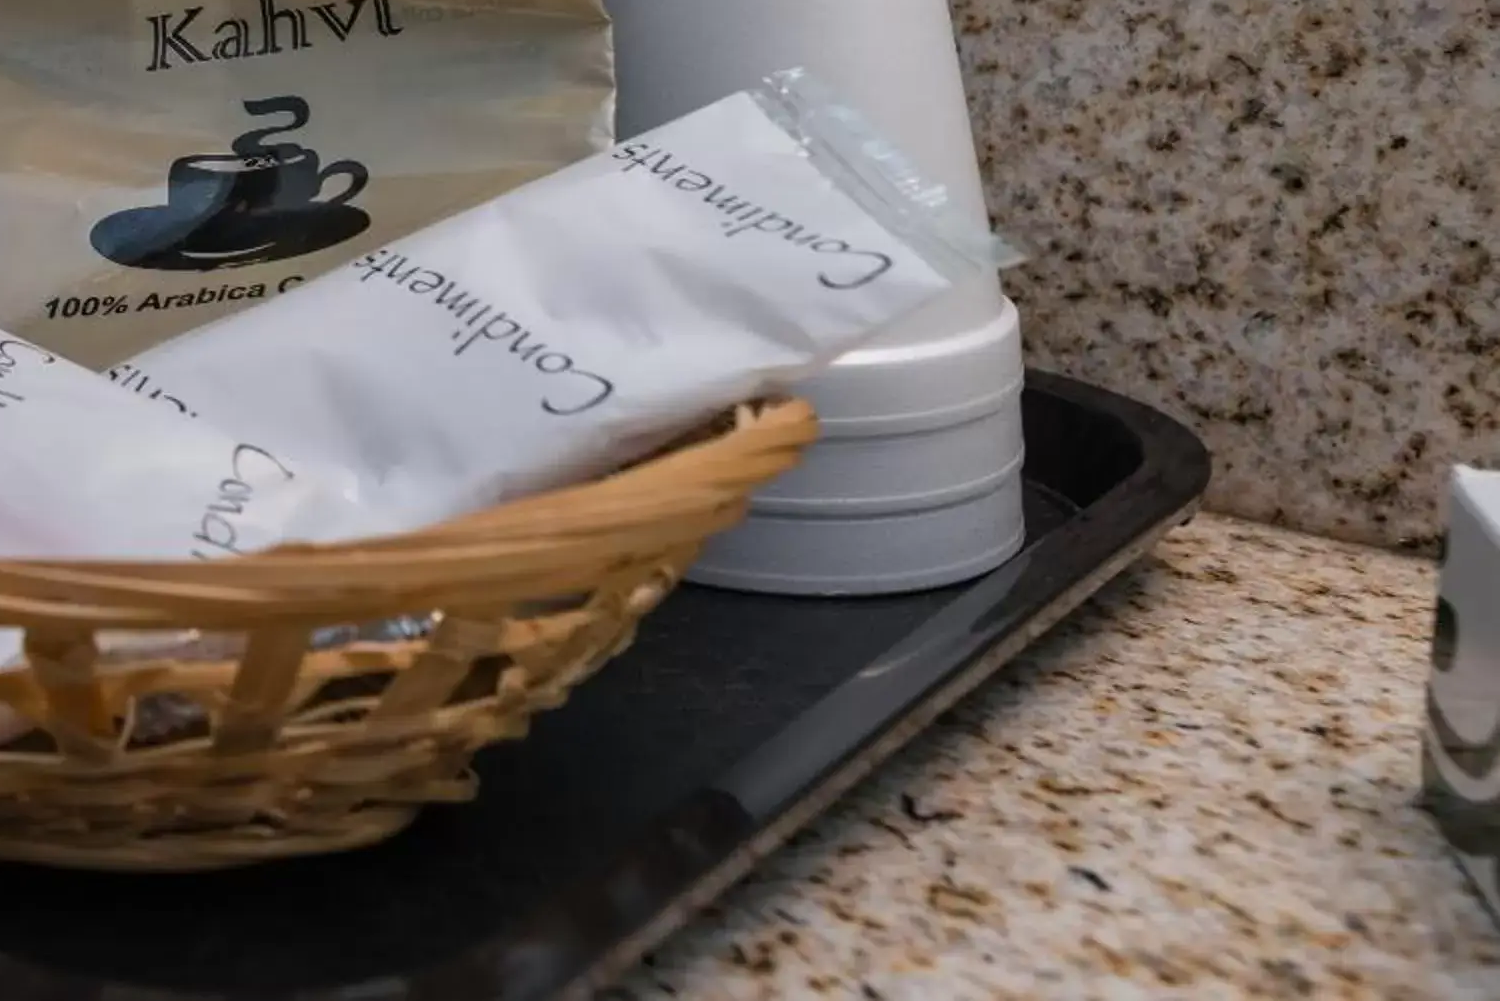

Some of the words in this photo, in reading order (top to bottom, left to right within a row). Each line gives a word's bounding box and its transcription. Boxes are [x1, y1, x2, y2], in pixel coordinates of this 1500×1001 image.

[611, 143, 892, 290] Condiments
[43, 295, 128, 319] 100%
[135, 282, 267, 313] Arabica
